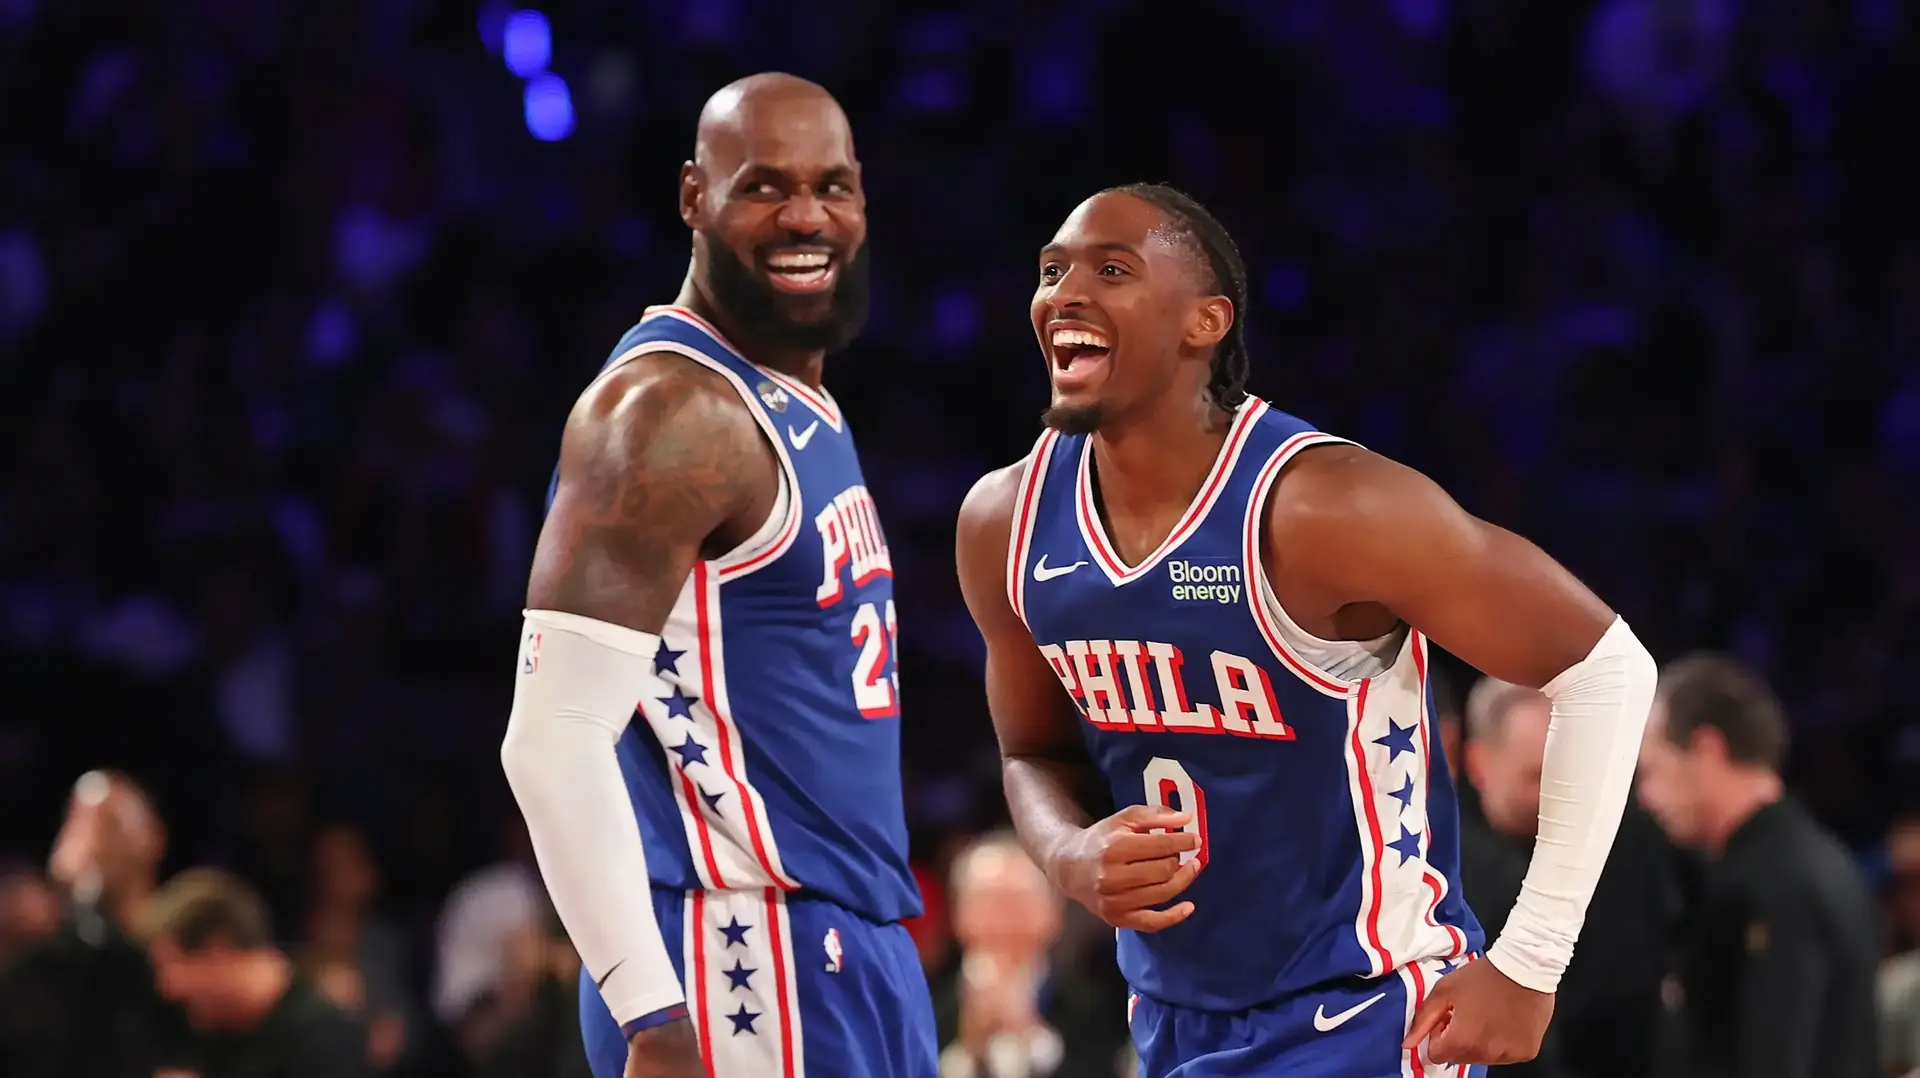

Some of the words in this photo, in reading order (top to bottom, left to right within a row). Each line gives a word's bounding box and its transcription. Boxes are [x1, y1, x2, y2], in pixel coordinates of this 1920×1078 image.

[1168, 560, 1240, 582] Bloom
[1172, 585, 1240, 604] energy
[1038, 639, 1297, 741] PHILA
